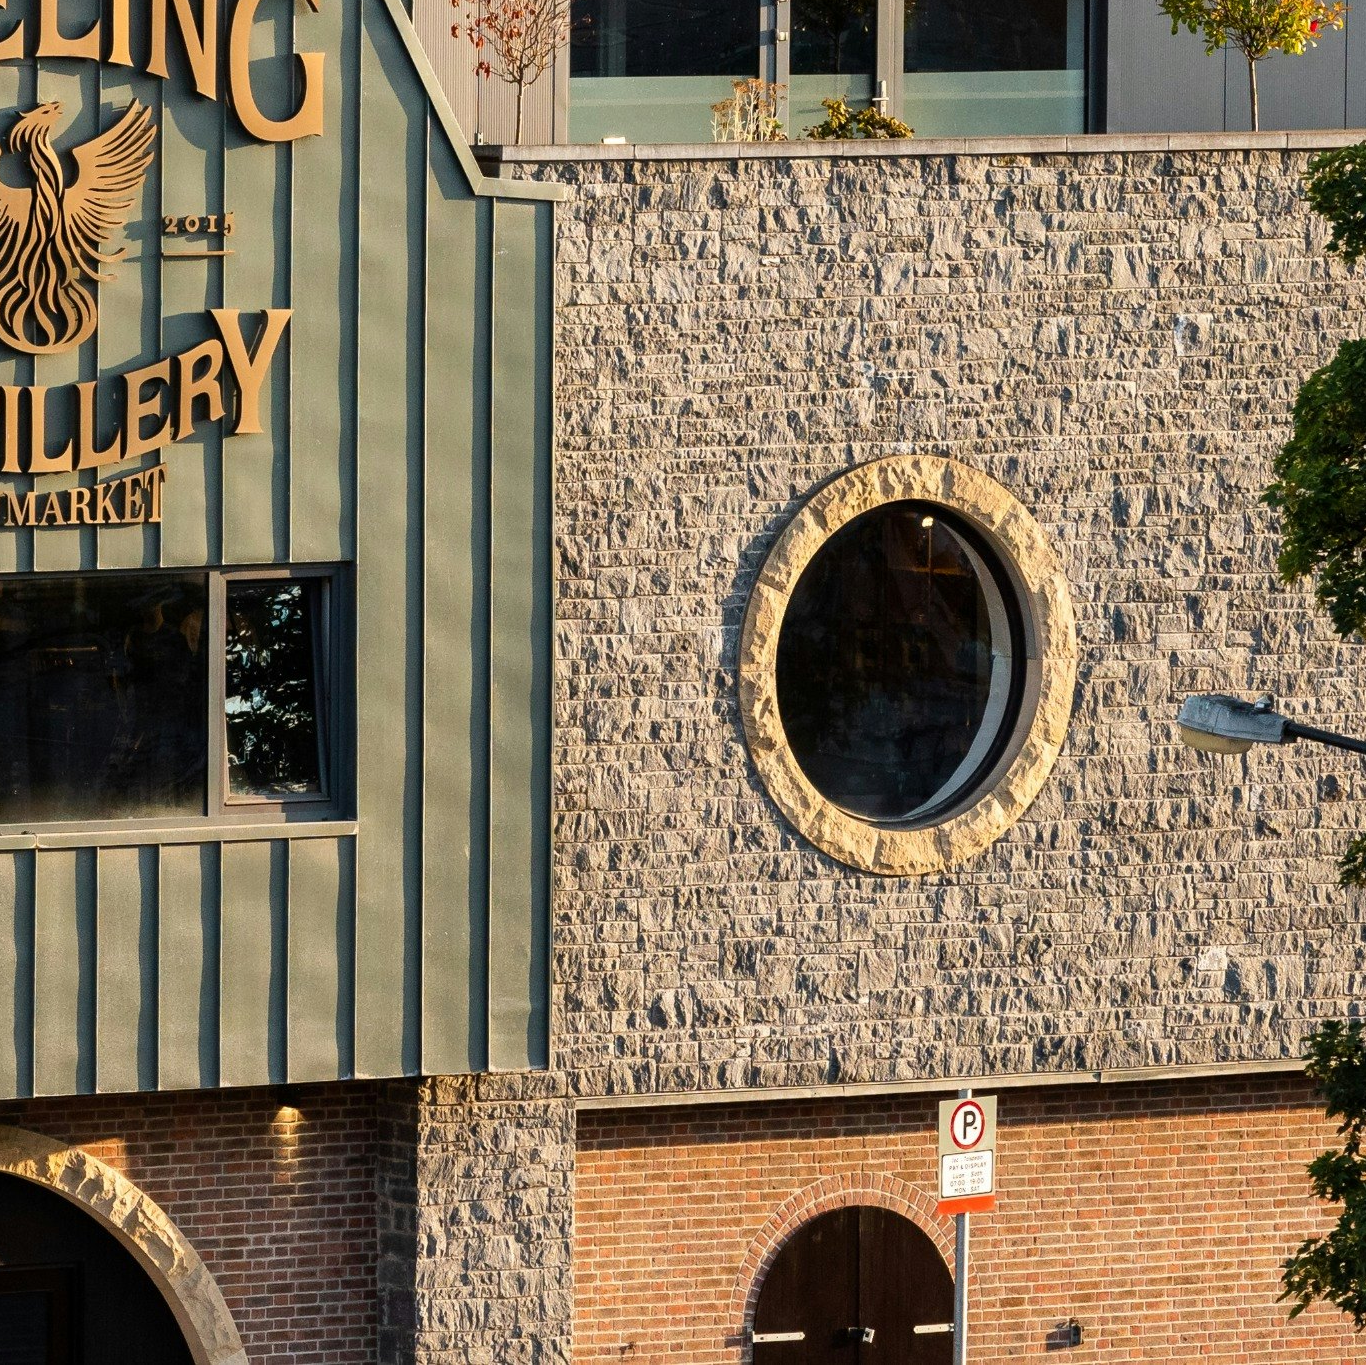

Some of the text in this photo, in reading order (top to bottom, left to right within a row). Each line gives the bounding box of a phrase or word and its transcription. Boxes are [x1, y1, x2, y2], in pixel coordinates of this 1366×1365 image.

[164, 212, 235, 237] 2015
[963, 1110, 977, 1140] P
[964, 1162, 987, 1170] DISPLAY
